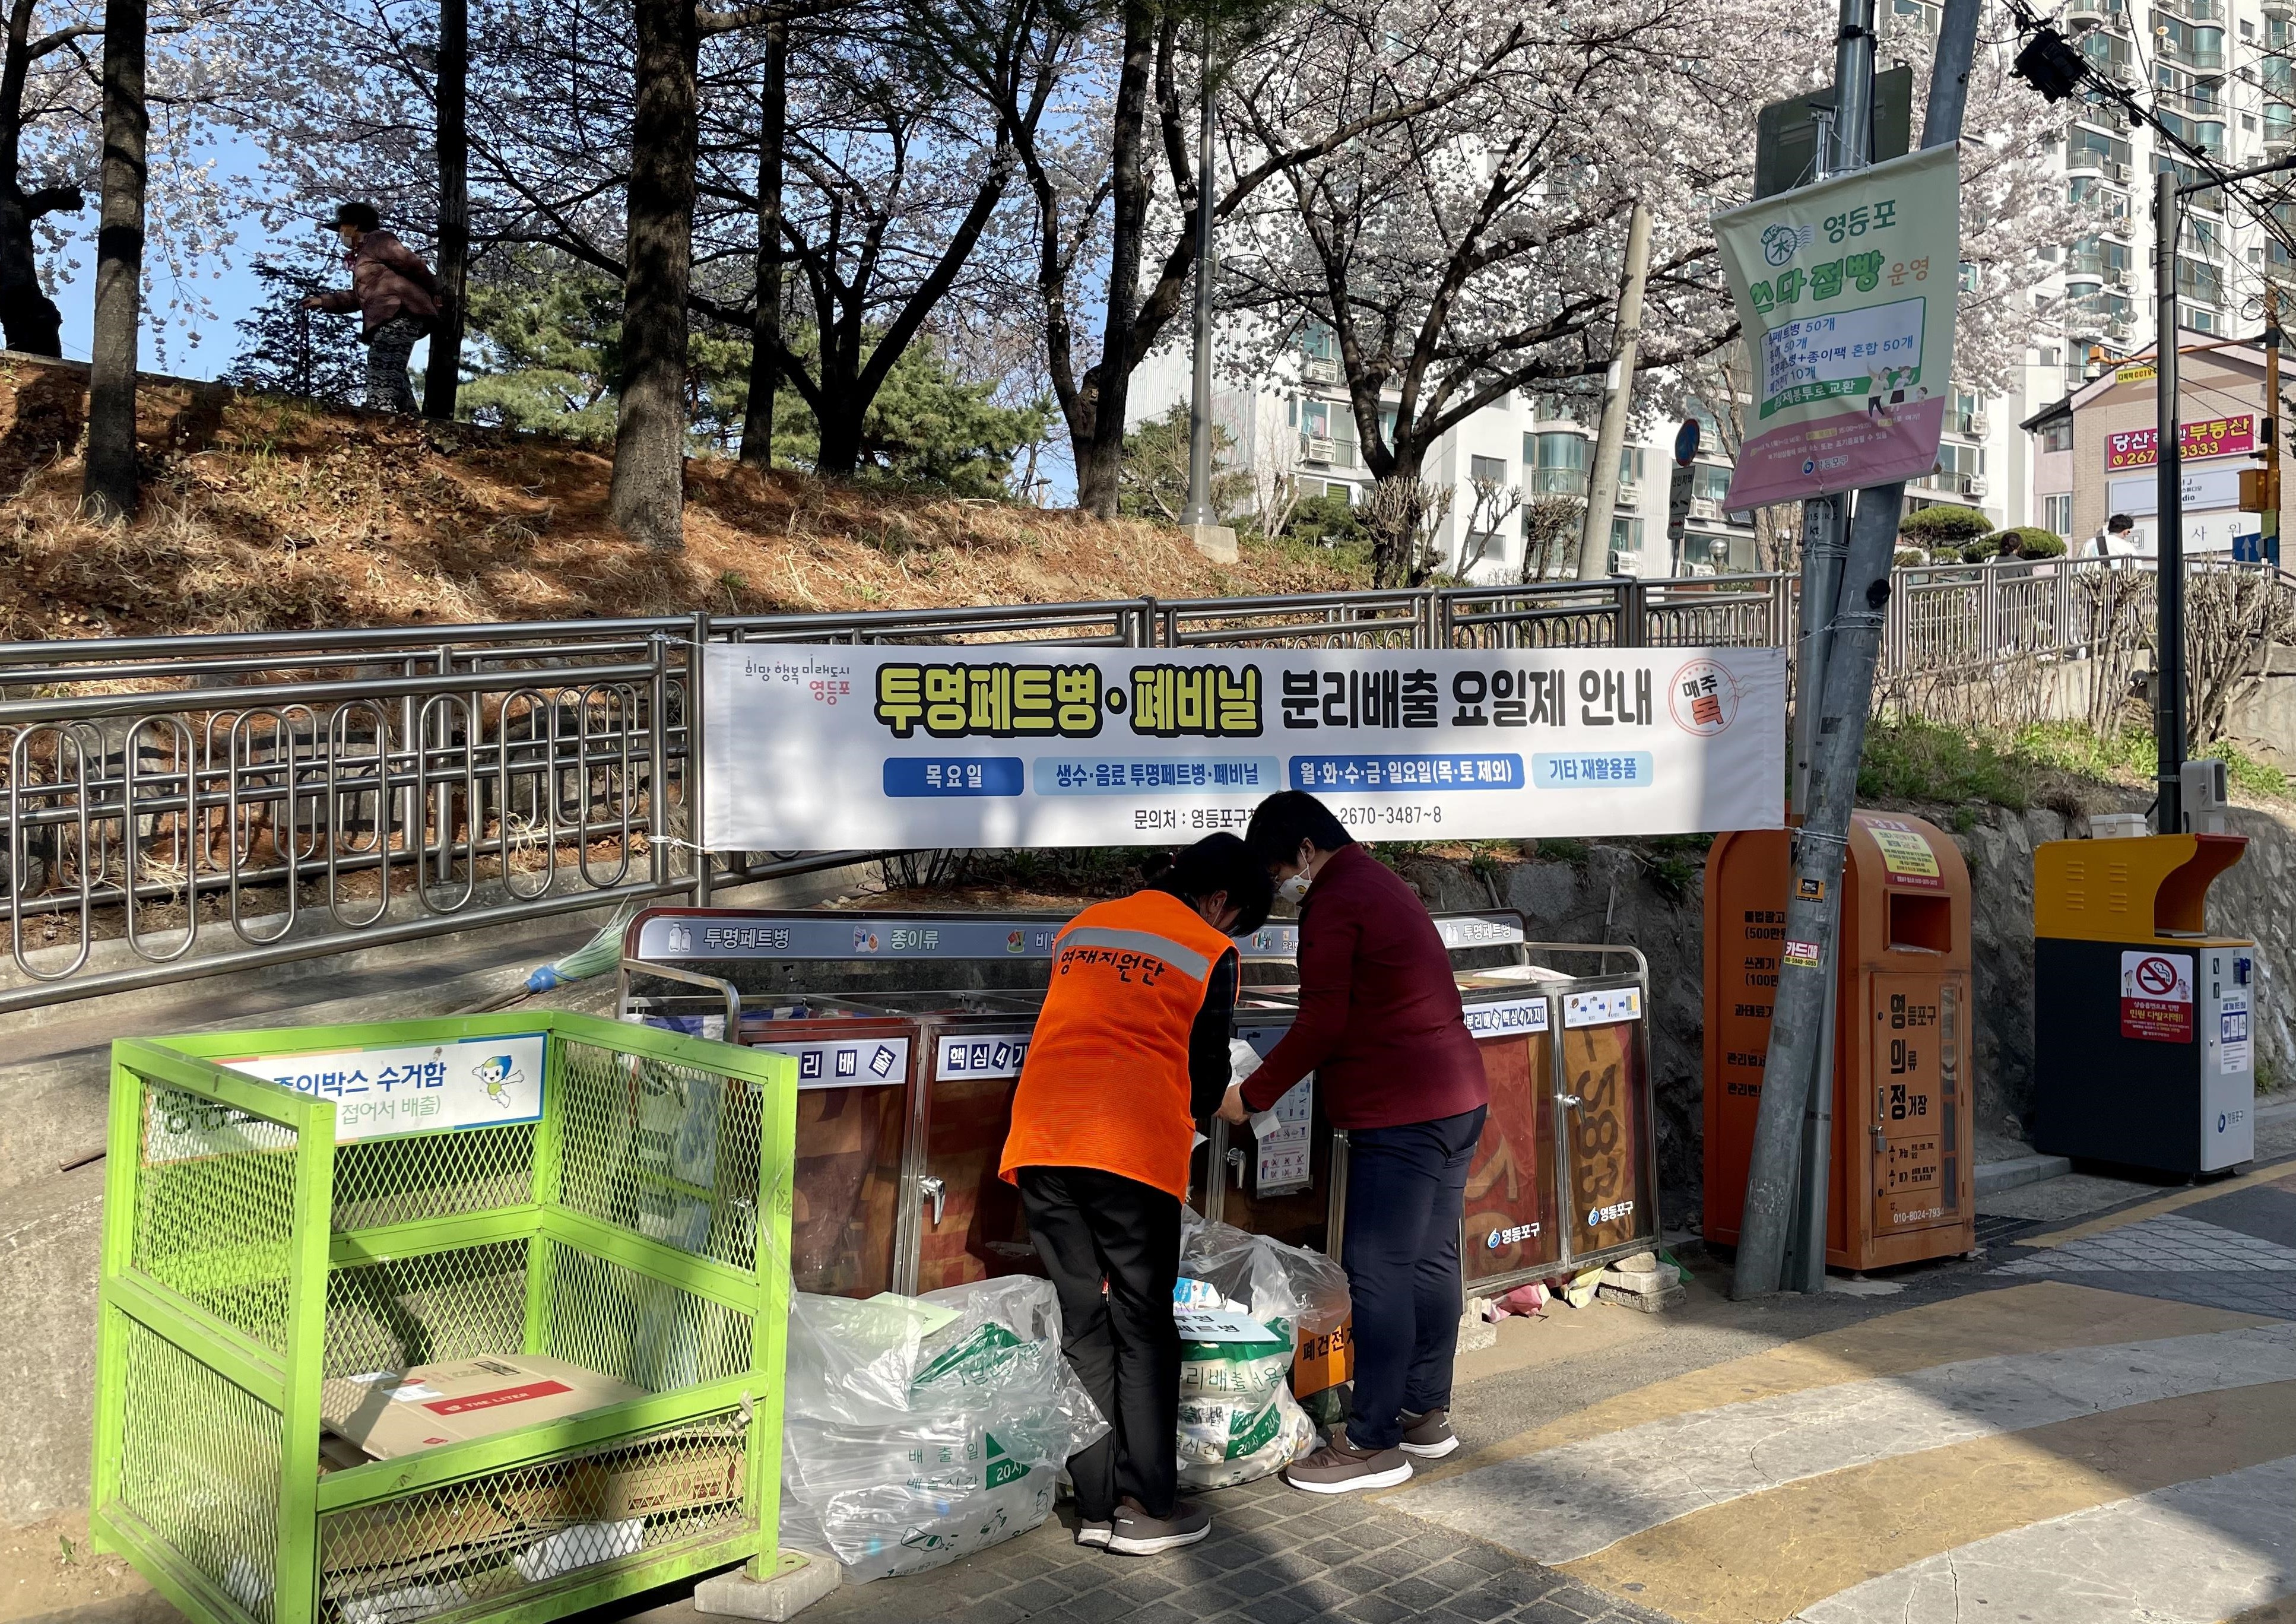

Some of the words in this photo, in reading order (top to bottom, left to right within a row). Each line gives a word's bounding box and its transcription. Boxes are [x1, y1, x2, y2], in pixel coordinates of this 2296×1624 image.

[1823, 199, 1897, 244] 영등포
[1886, 255, 1930, 287] 운영
[1805, 317, 1835, 333] 50개
[1783, 337, 1807, 353] 50개
[1851, 341, 1879, 358] 혼합
[1882, 335, 1914, 352] 50개
[1790, 365, 1817, 380] 10개
[2134, 370, 2152, 378] CCTV
[1828, 379, 1856, 395] 교환
[2112, 432, 2150, 453] 당산
[2189, 417, 2250, 442] 부동산
[745, 655, 771, 682] 희망
[774, 661, 799, 685] 행복
[803, 654, 850, 678] 미래도시
[809, 680, 850, 706] 영등포
[1281, 668, 1438, 729] 분리배출
[1451, 668, 1566, 728] 요일제
[1578, 667, 1653, 727] 안내
[1682, 674, 1718, 700] 매주
[1690, 694, 1724, 726] 목
[925, 763, 983, 789] 목요일
[1056, 763, 1127, 788] 생수·음료
[1130, 762, 1259, 786] 투명페트병·폐비닐
[1476, 759, 1512, 784] 제외)
[1549, 758, 1578, 781] 기타
[1580, 757, 1637, 780] 재활용품
[1134, 809, 1176, 829] 문의처
[704, 927, 790, 950] 투명페트병
[890, 928, 940, 950] 종이류
[1463, 921, 1511, 941] 투명페트병
[1744, 956, 1775, 970] 쓰레기
[376, 1061, 447, 1092] 수거함
[342, 1099, 395, 1125] 접어서
[401, 1095, 441, 1117] 배출)
[1600, 1200, 1634, 1222] 영등포구
[1501, 1222, 1540, 1245] 영등포구
[464, 1399, 492, 1409] THE
[492, 1392, 530, 1403] LITER
